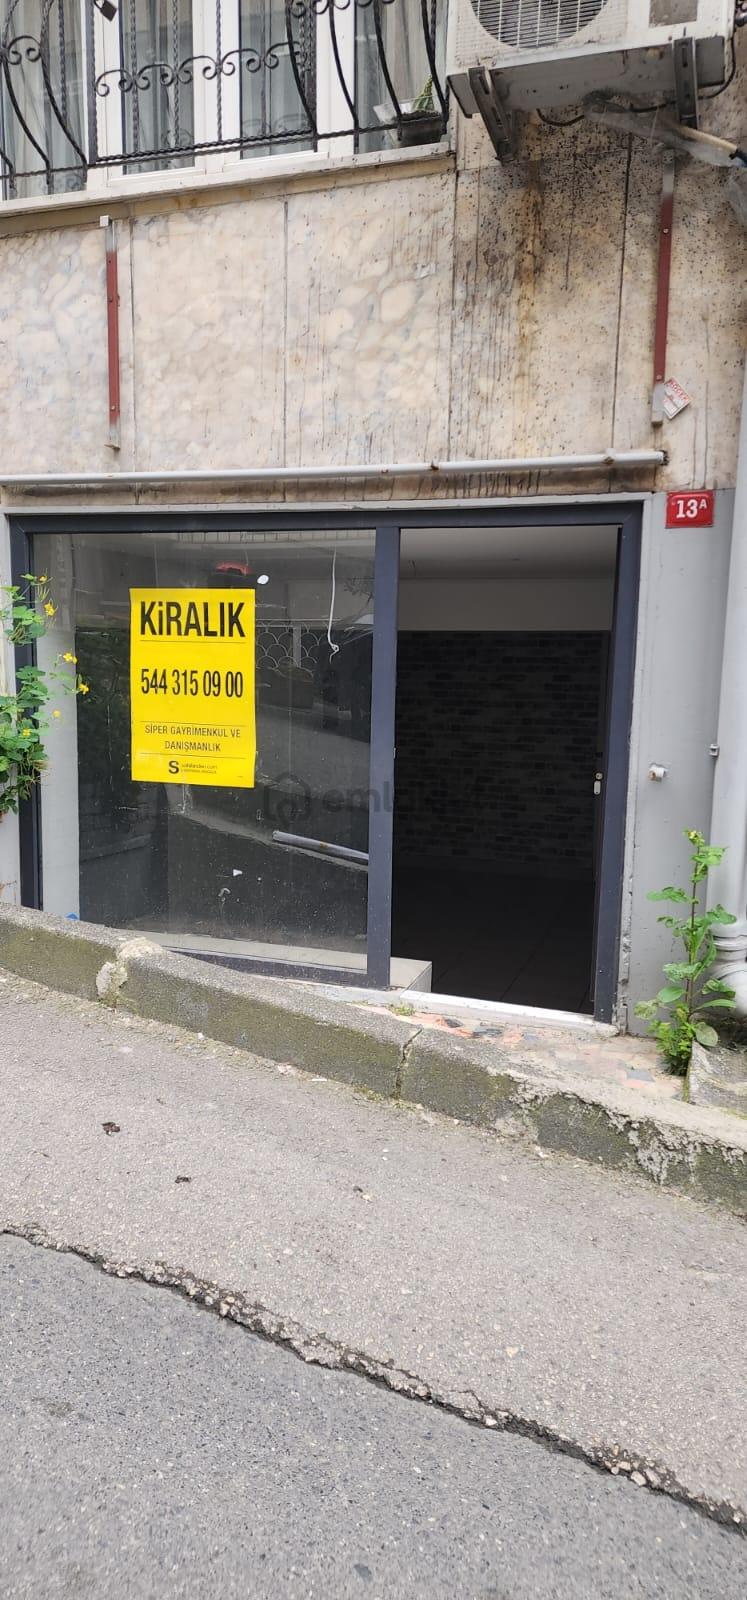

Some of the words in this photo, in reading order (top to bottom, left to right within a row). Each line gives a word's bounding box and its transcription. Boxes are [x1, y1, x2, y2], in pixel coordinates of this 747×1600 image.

[141, 668, 168, 695] 544
[171, 669, 198, 696] 315
[203, 670, 221, 697] 09
[225, 671, 243, 698] 00
[144, 724, 168, 734] SİPER
[164, 740, 221, 752] DANIŞMANLIK
